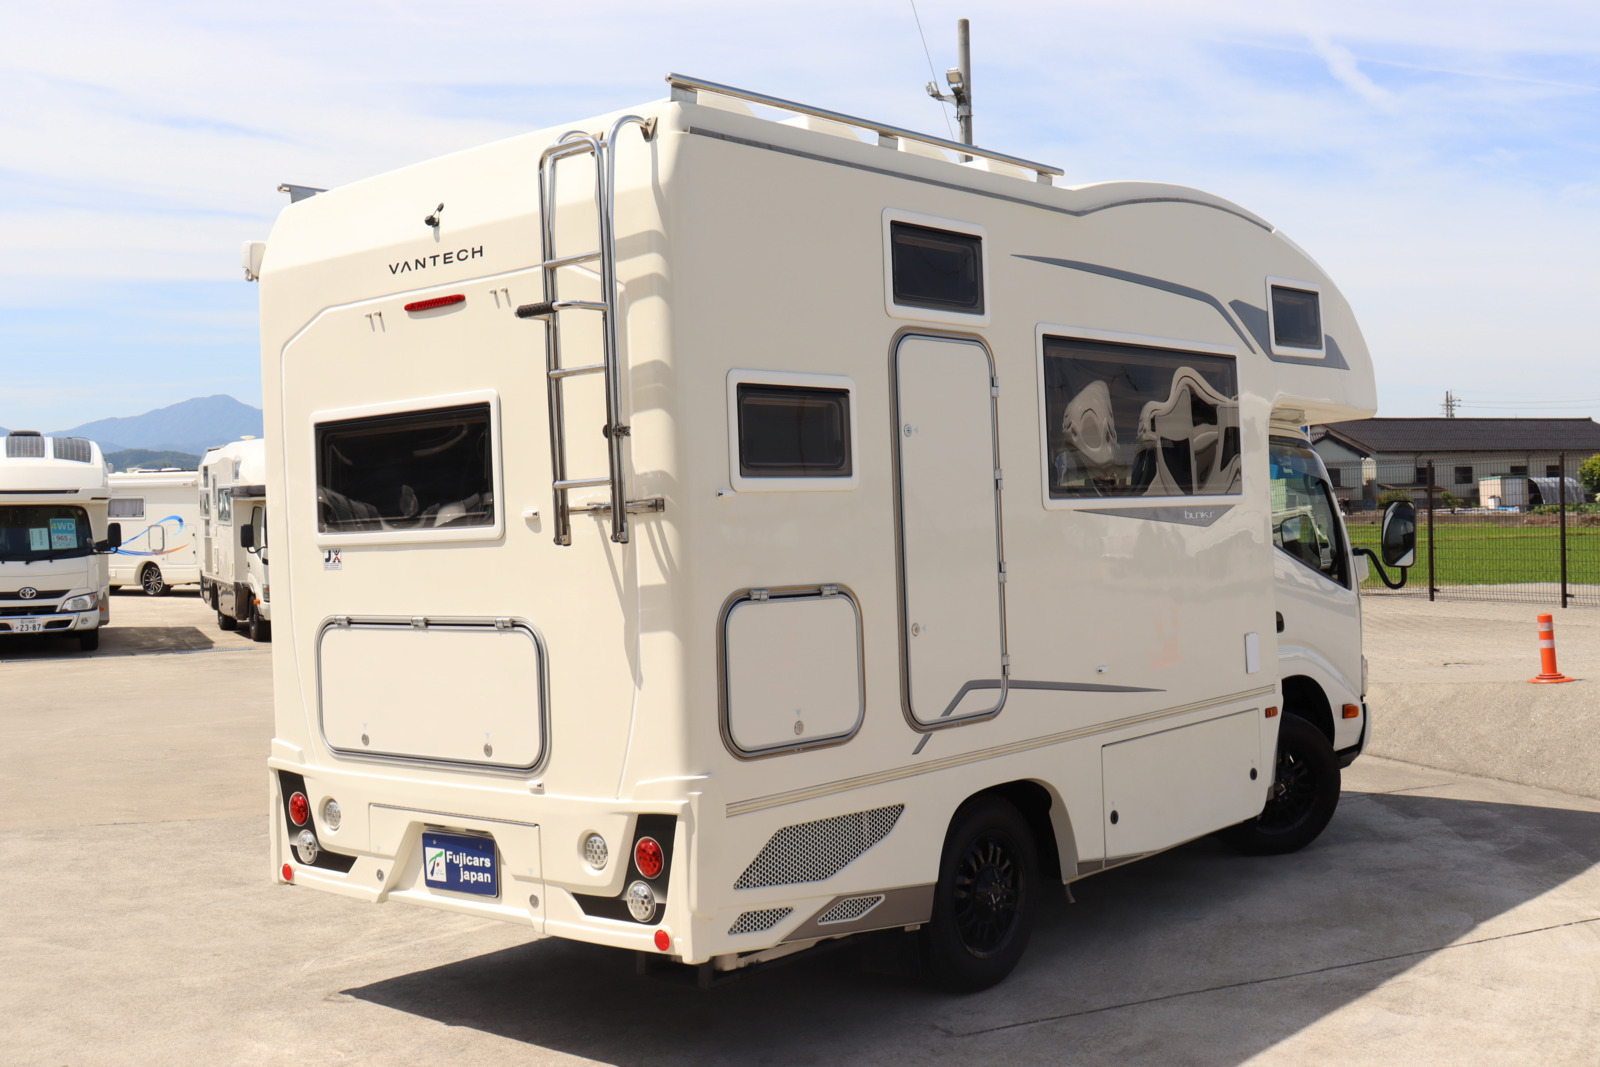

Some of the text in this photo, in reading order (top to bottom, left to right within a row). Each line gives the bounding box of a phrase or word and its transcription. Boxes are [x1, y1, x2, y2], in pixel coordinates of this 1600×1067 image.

[388, 245, 483, 275] VANTECH
[51, 522, 76, 531] 4WD
[446, 850, 492, 868] Fujicars
[459, 867, 492, 884] japan
